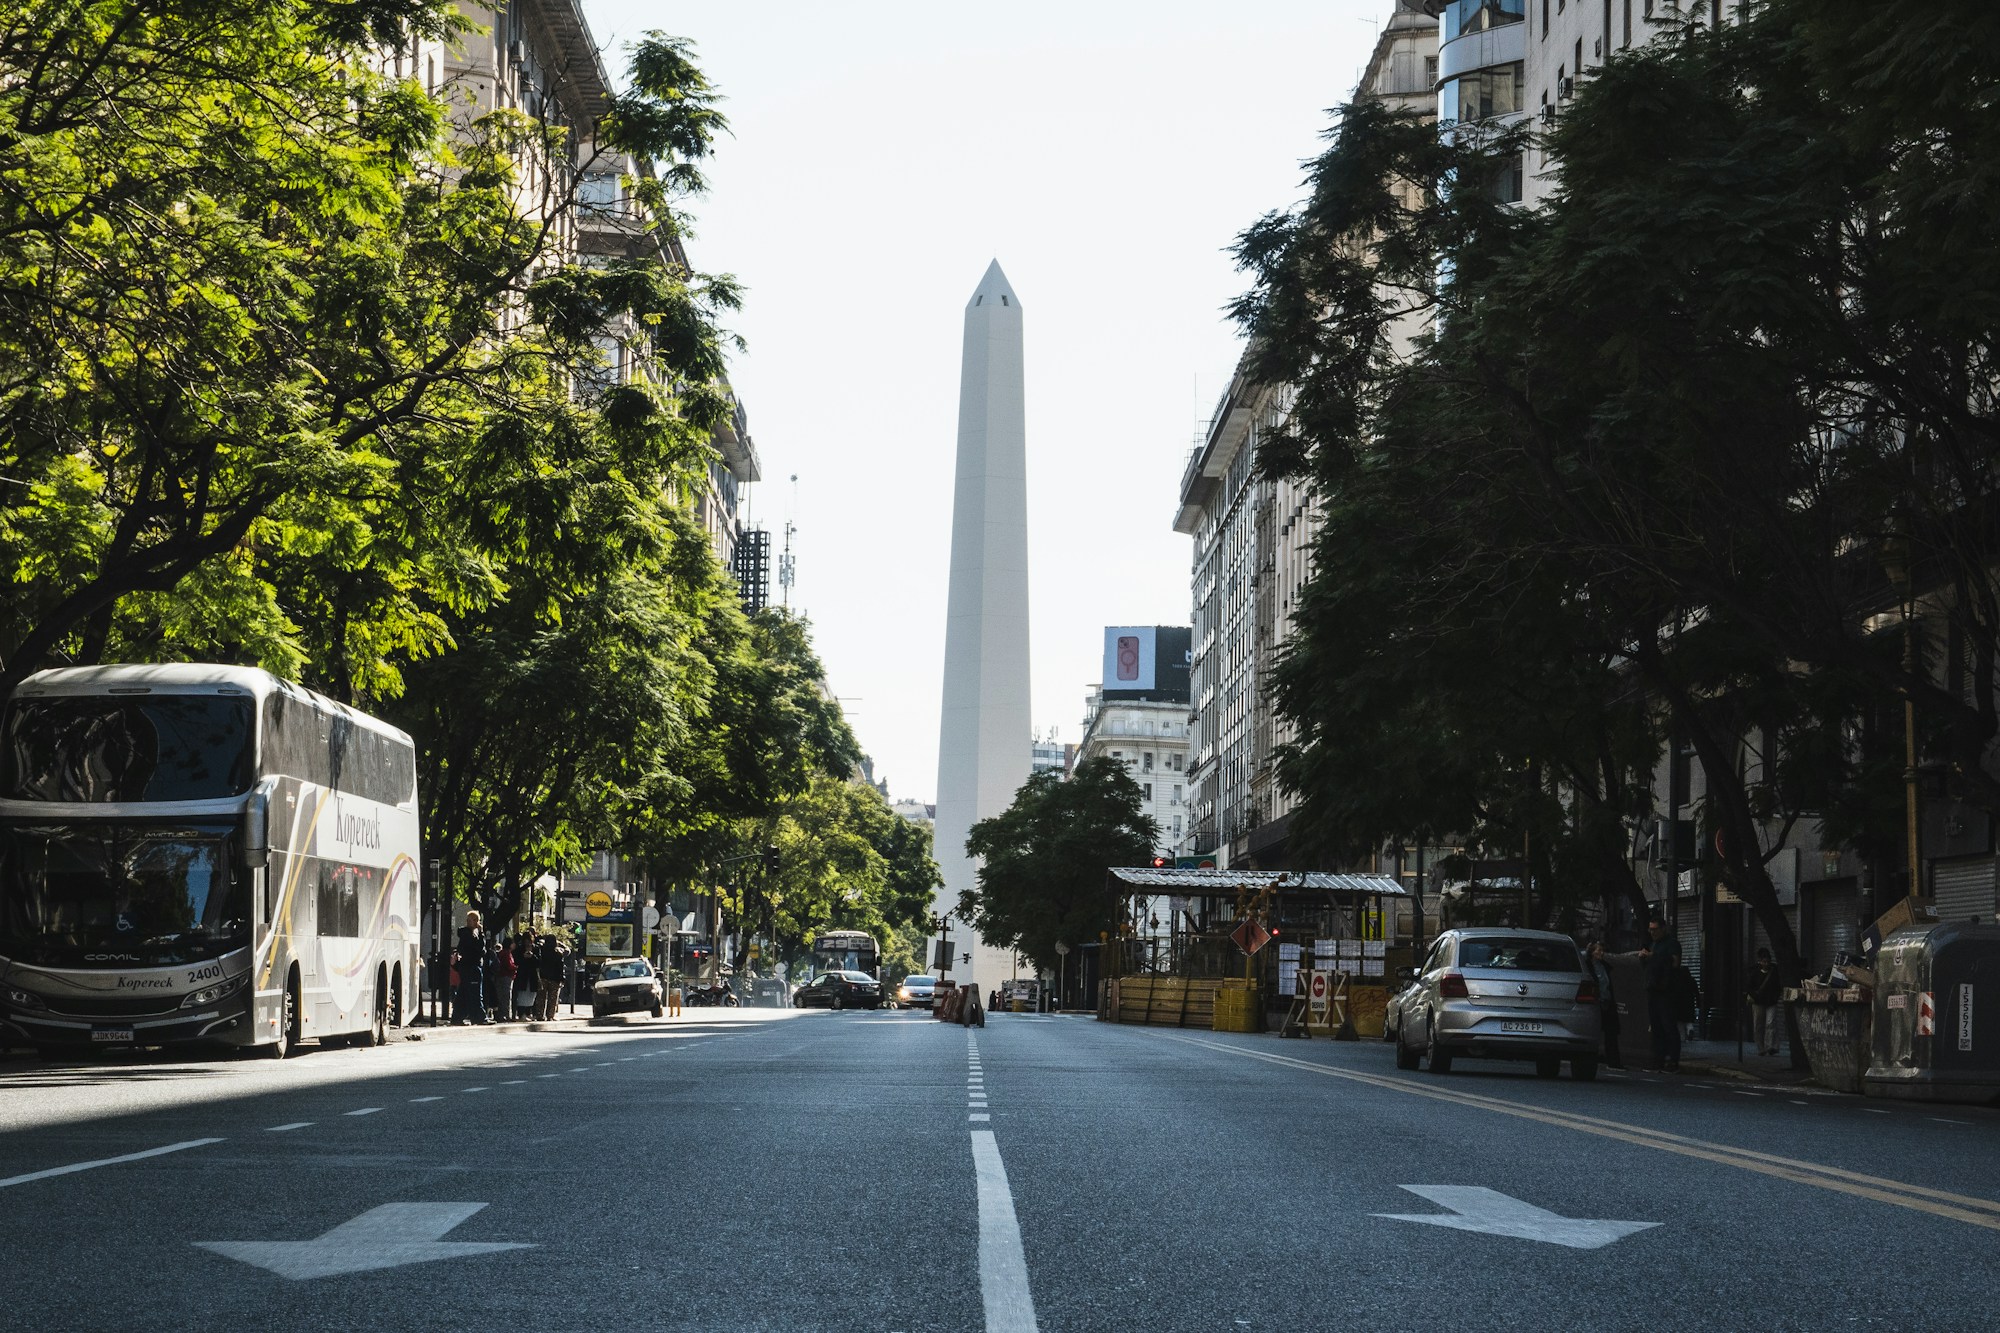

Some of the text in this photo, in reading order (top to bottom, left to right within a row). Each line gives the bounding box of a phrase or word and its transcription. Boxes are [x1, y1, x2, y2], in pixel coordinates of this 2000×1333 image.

[336, 796, 381, 858] Kopereck
[187, 966, 220, 984] 2400
[117, 977, 174, 991] Kopereck
[1503, 1022, 1513, 1030] AC
[1531, 1023, 1542, 1031] FP
